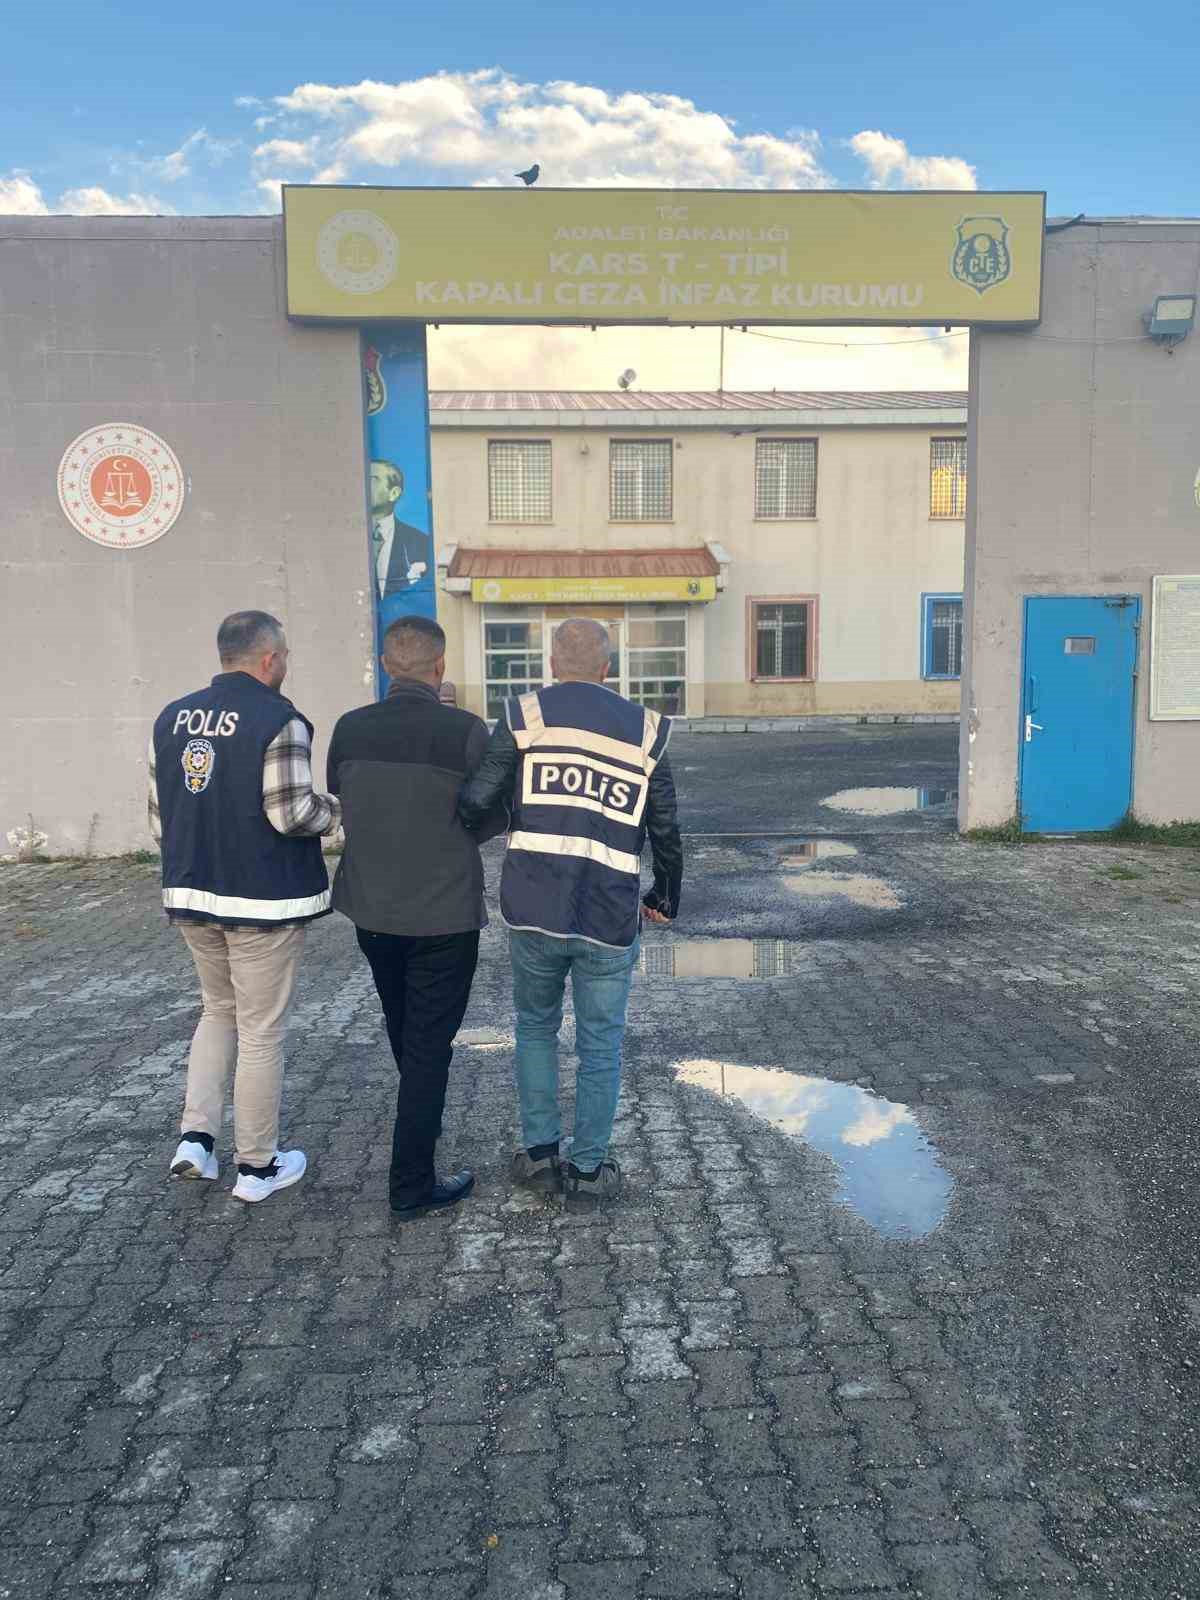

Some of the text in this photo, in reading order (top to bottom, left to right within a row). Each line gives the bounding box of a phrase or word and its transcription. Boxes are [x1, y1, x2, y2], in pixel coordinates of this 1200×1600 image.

[553, 224, 649, 241] ADALET
[548, 252, 649, 276] KARS
[660, 252, 686, 276] T
[725, 247, 788, 276] TİPİ
[414, 276, 924, 308] KAPALI CEZA İNFAZ KURUMU
